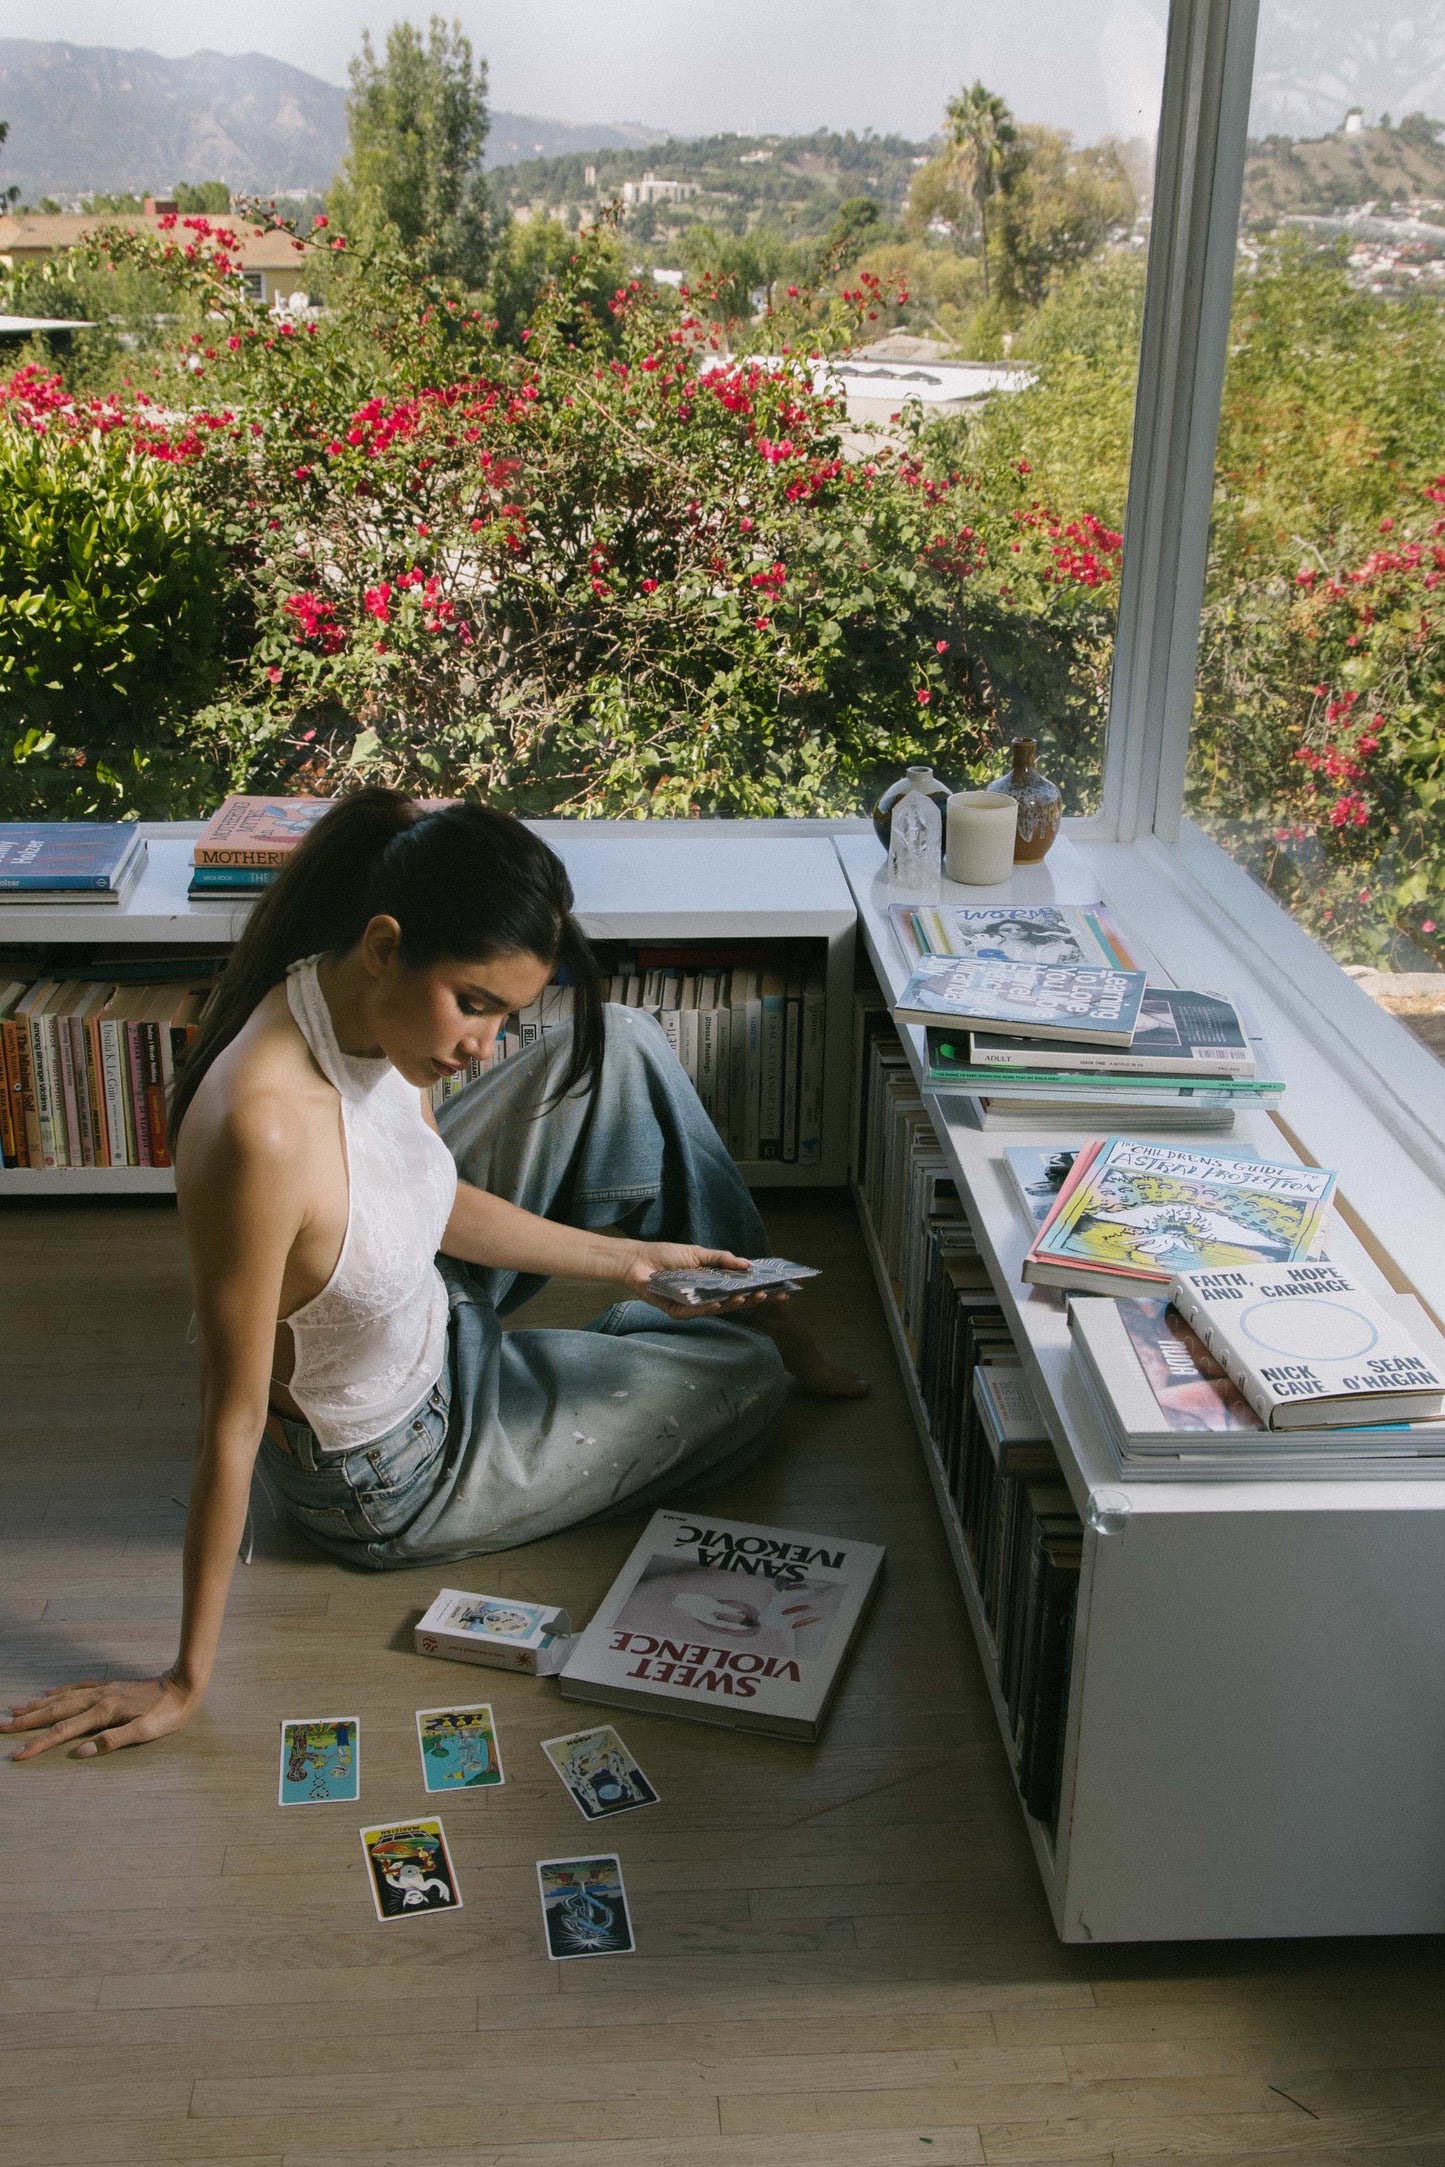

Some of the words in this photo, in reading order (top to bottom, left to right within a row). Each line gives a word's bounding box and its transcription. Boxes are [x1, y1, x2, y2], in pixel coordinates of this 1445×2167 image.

[10, 840, 45, 864] Holzer
[202, 850, 285, 865] MOTHERI
[0, 879, 20, 887] olzer
[249, 872, 270, 883] THE
[1044, 967, 1078, 990] You
[1074, 969, 1108, 986] To
[1066, 984, 1103, 1013] Love
[1090, 969, 1138, 1020] Learning
[33, 1022, 43, 1050] Among
[103, 1024, 114, 1053] Ursula
[146, 1024, 155, 1040] Today
[704, 1016, 712, 1041] Ottessa
[18, 1034, 27, 1052] The
[148, 1044, 156, 1061] Wrote
[36, 1051, 45, 1082] Strange
[106, 1053, 115, 1063] K.
[703, 1043, 712, 1074] Moshfegh
[985, 1054, 1012, 1063] ADULT
[20, 1054, 33, 1092] Minimal
[107, 1065, 117, 1076] Le
[149, 1062, 158, 1084] Nothing
[768, 1055, 777, 1101] STRANGE
[40, 1084, 49, 1112] Victims
[108, 1078, 119, 1101] Guin
[24, 1094, 35, 1113] Self
[767, 1107, 775, 1136] LOOP
[1110, 1153, 1198, 1176] ASTRAL
[1200, 1166, 1321, 1193] PROJECTION
[1233, 1162, 1291, 1178] GUIDE
[1189, 1273, 1255, 1288] FAITH,
[1287, 1267, 1344, 1282] HOPE
[1201, 1287, 1243, 1302] AND
[1259, 1279, 1356, 1298] CARNAGE
[1259, 1365, 1317, 1381] NICK
[1366, 1355, 1427, 1373] SEÁN
[1272, 1381, 1330, 1397] CAVE
[1342, 1371, 1440, 1390] O'HAGAN
[673, 1524, 847, 1570] IVEKOVIĆ
[697, 1548, 810, 1582] SANJA
[609, 1630, 801, 1682] VIOLENCE
[626, 1657, 762, 1698] SWEET
[566, 1735, 592, 1747] MOON
[380, 1824, 421, 1836] MAGICIAN
